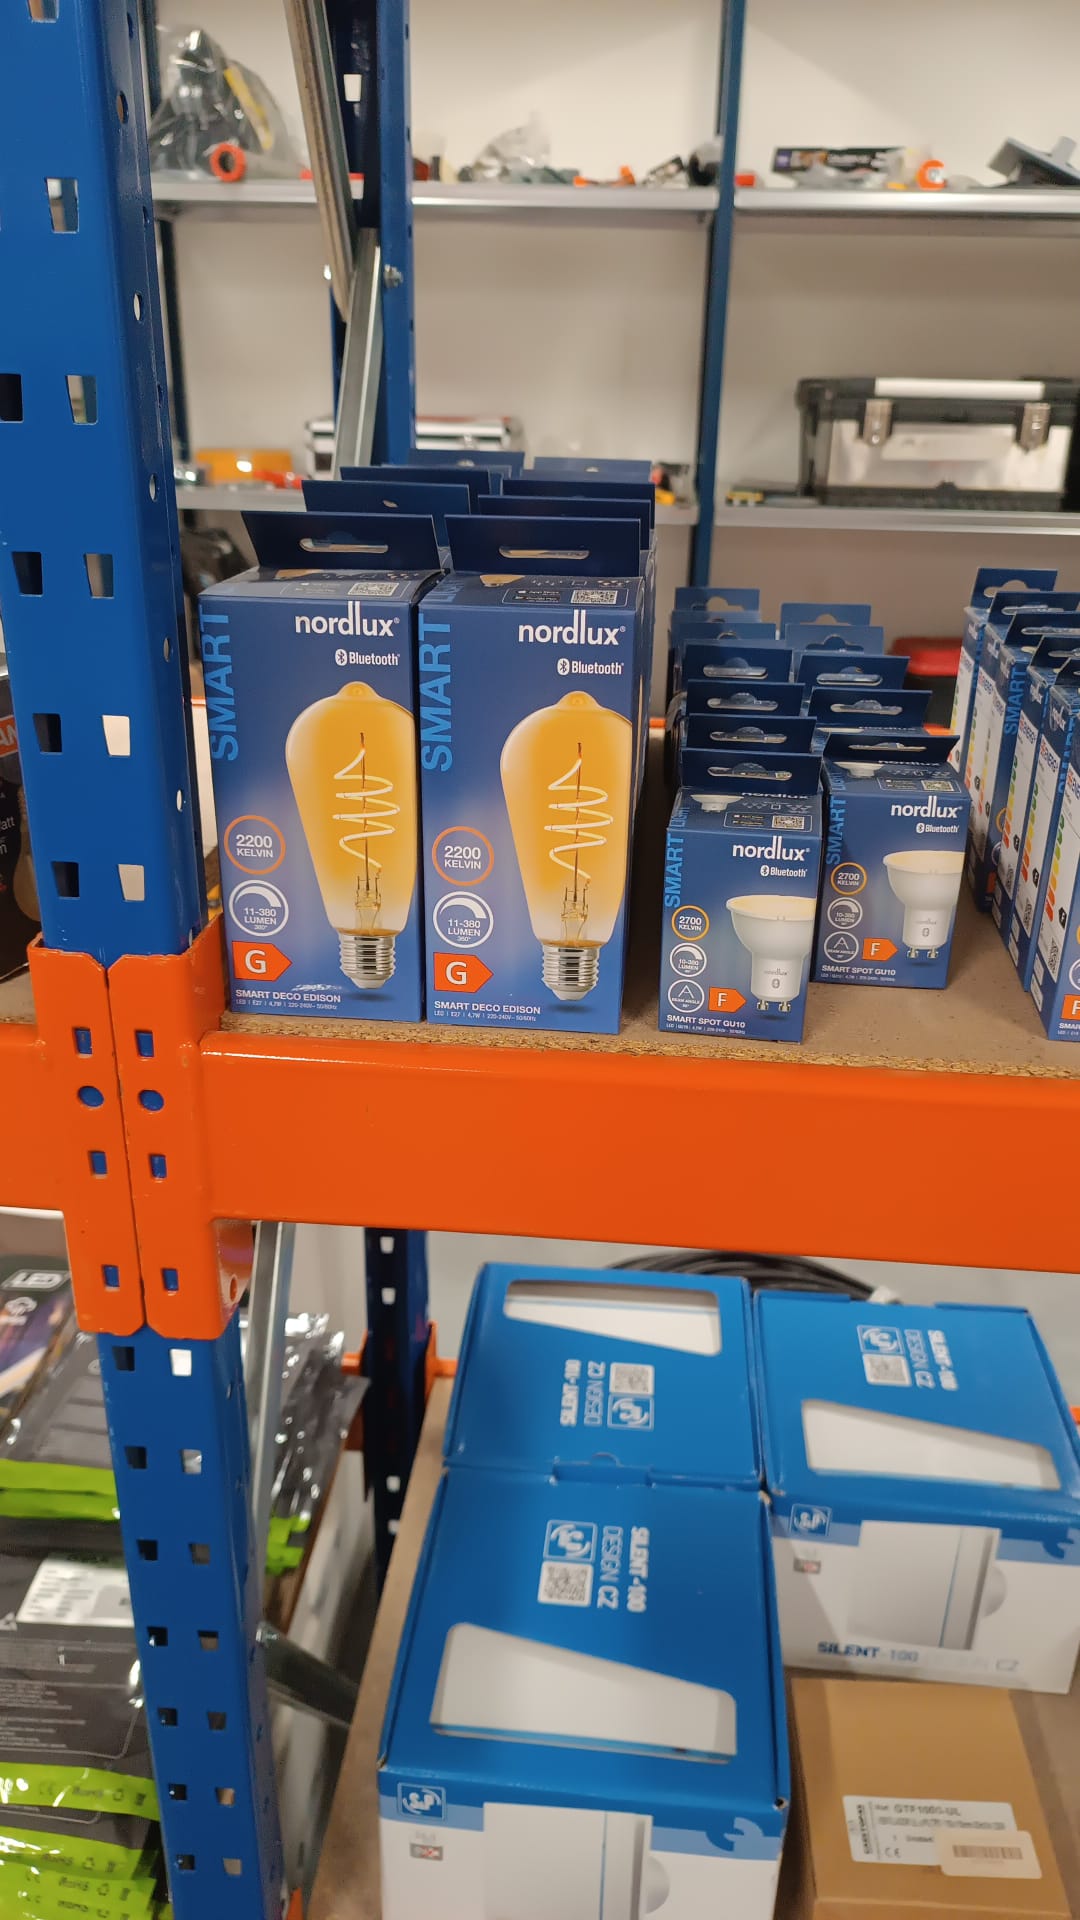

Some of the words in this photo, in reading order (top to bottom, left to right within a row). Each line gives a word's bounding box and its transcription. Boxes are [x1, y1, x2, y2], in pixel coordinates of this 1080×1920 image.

[348, 651, 399, 666] Bluetooth
[571, 660, 624, 675] Bluetooth
[199, 605, 239, 761] SMART
[418, 613, 453, 772] SMART
[1004, 667, 1027, 736] SMART
[826, 795, 847, 865] SMART
[235, 834, 273, 849] 2200
[236, 847, 274, 858] KELVIN
[444, 845, 482, 860] 2200
[444, 859, 482, 869] KELVIN
[665, 833, 684, 908] SMART
[770, 867, 808, 877] Bluetooth
[838, 872, 860, 881] 2700
[244, 907, 277, 917] 11-380
[244, 916, 277, 925] LUMEN
[447, 919, 481, 929] 11-380
[679, 915, 702, 926] 2700
[447, 928, 481, 936] LUMEN
[870, 943, 881, 956] F
[245, 949, 267, 974] G
[821, 965, 850, 973] SMART
[445, 961, 467, 985] G
[235, 989, 271, 998] SMART
[272, 991, 302, 1001] DECO
[303, 994, 341, 1003] EDISON
[718, 992, 728, 1007] F
[434, 1001, 470, 1010] SMART
[471, 1003, 501, 1012] DECO
[503, 1005, 541, 1015] EDISON
[666, 1014, 697, 1024] SMART
[698, 1017, 721, 1026] SPOT
[723, 1020, 746, 1028] GU10
[12, 1272, 65, 1289] LED
[587, 1360, 606, 1379] CZ
[600, 1525, 624, 1582] DESIGN
[597, 1585, 619, 1611] CZ
[817, 1641, 880, 1659] SILENT
